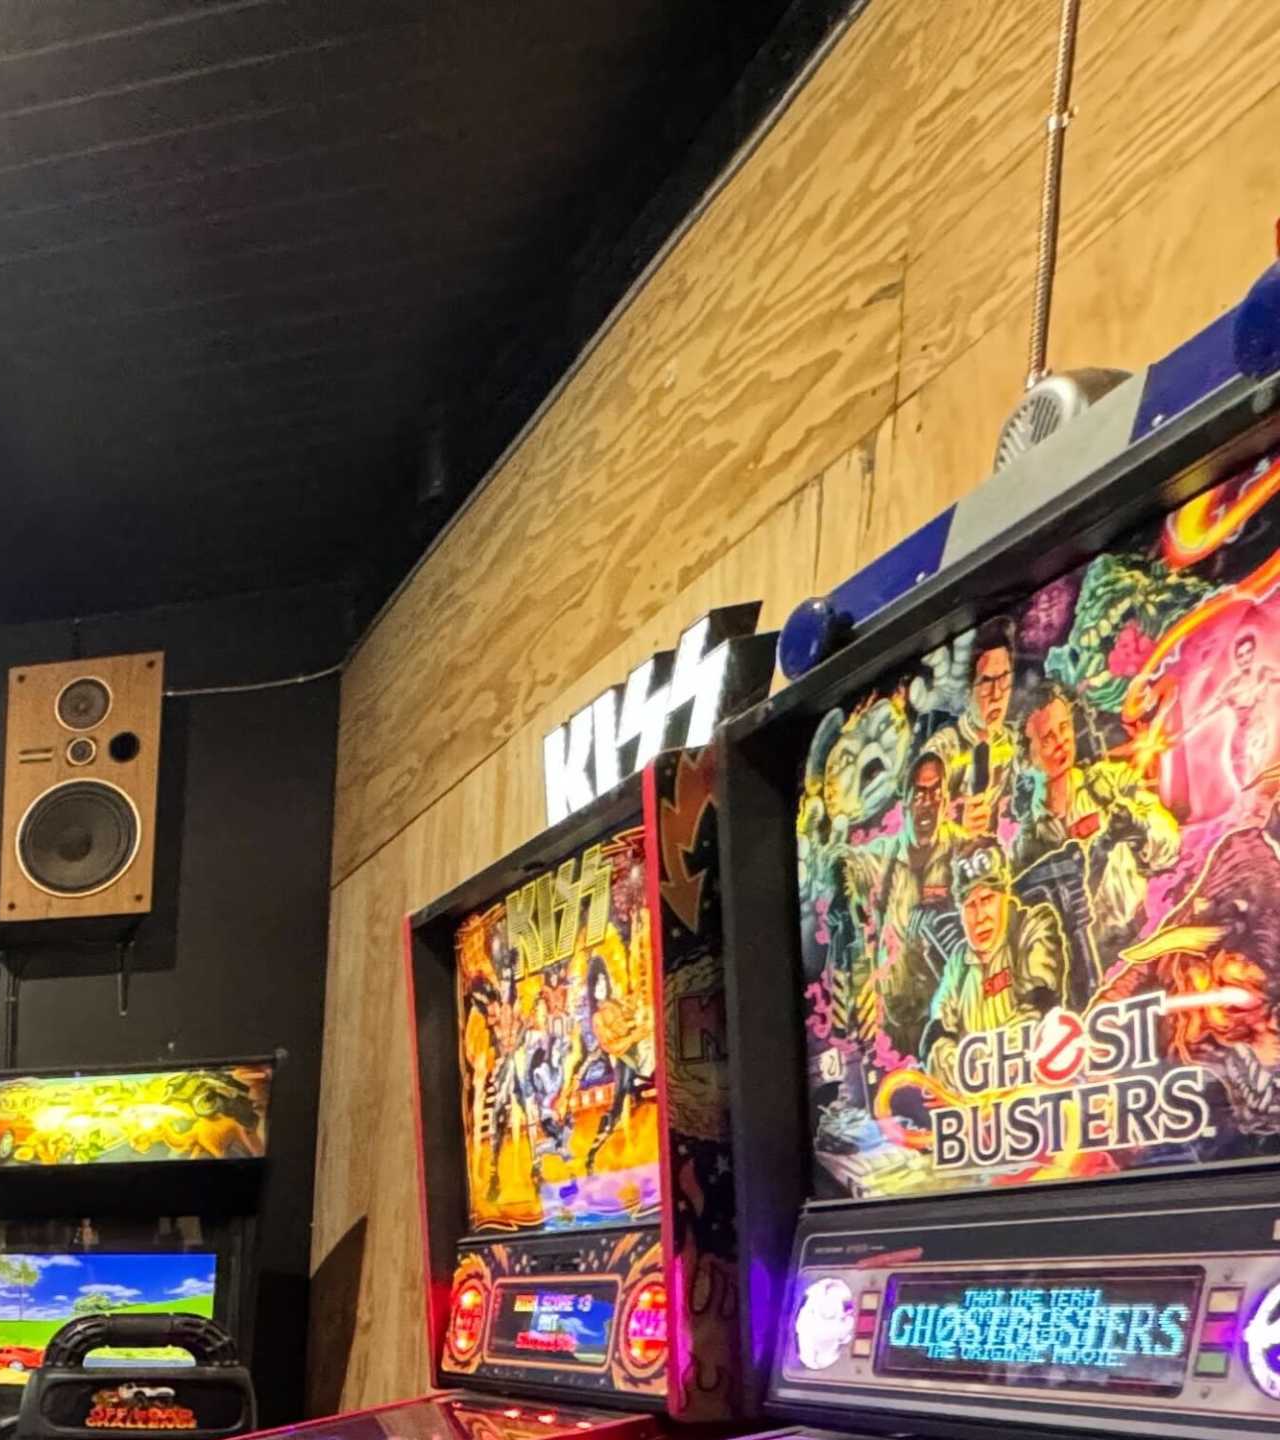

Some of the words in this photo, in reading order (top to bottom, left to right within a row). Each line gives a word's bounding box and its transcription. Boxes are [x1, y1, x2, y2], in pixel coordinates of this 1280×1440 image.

[543, 617, 729, 828] KISS
[504, 843, 613, 982] KISS
[930, 1065, 1211, 1168] BUSTERS
[91, 1407, 127, 1420] OFF
